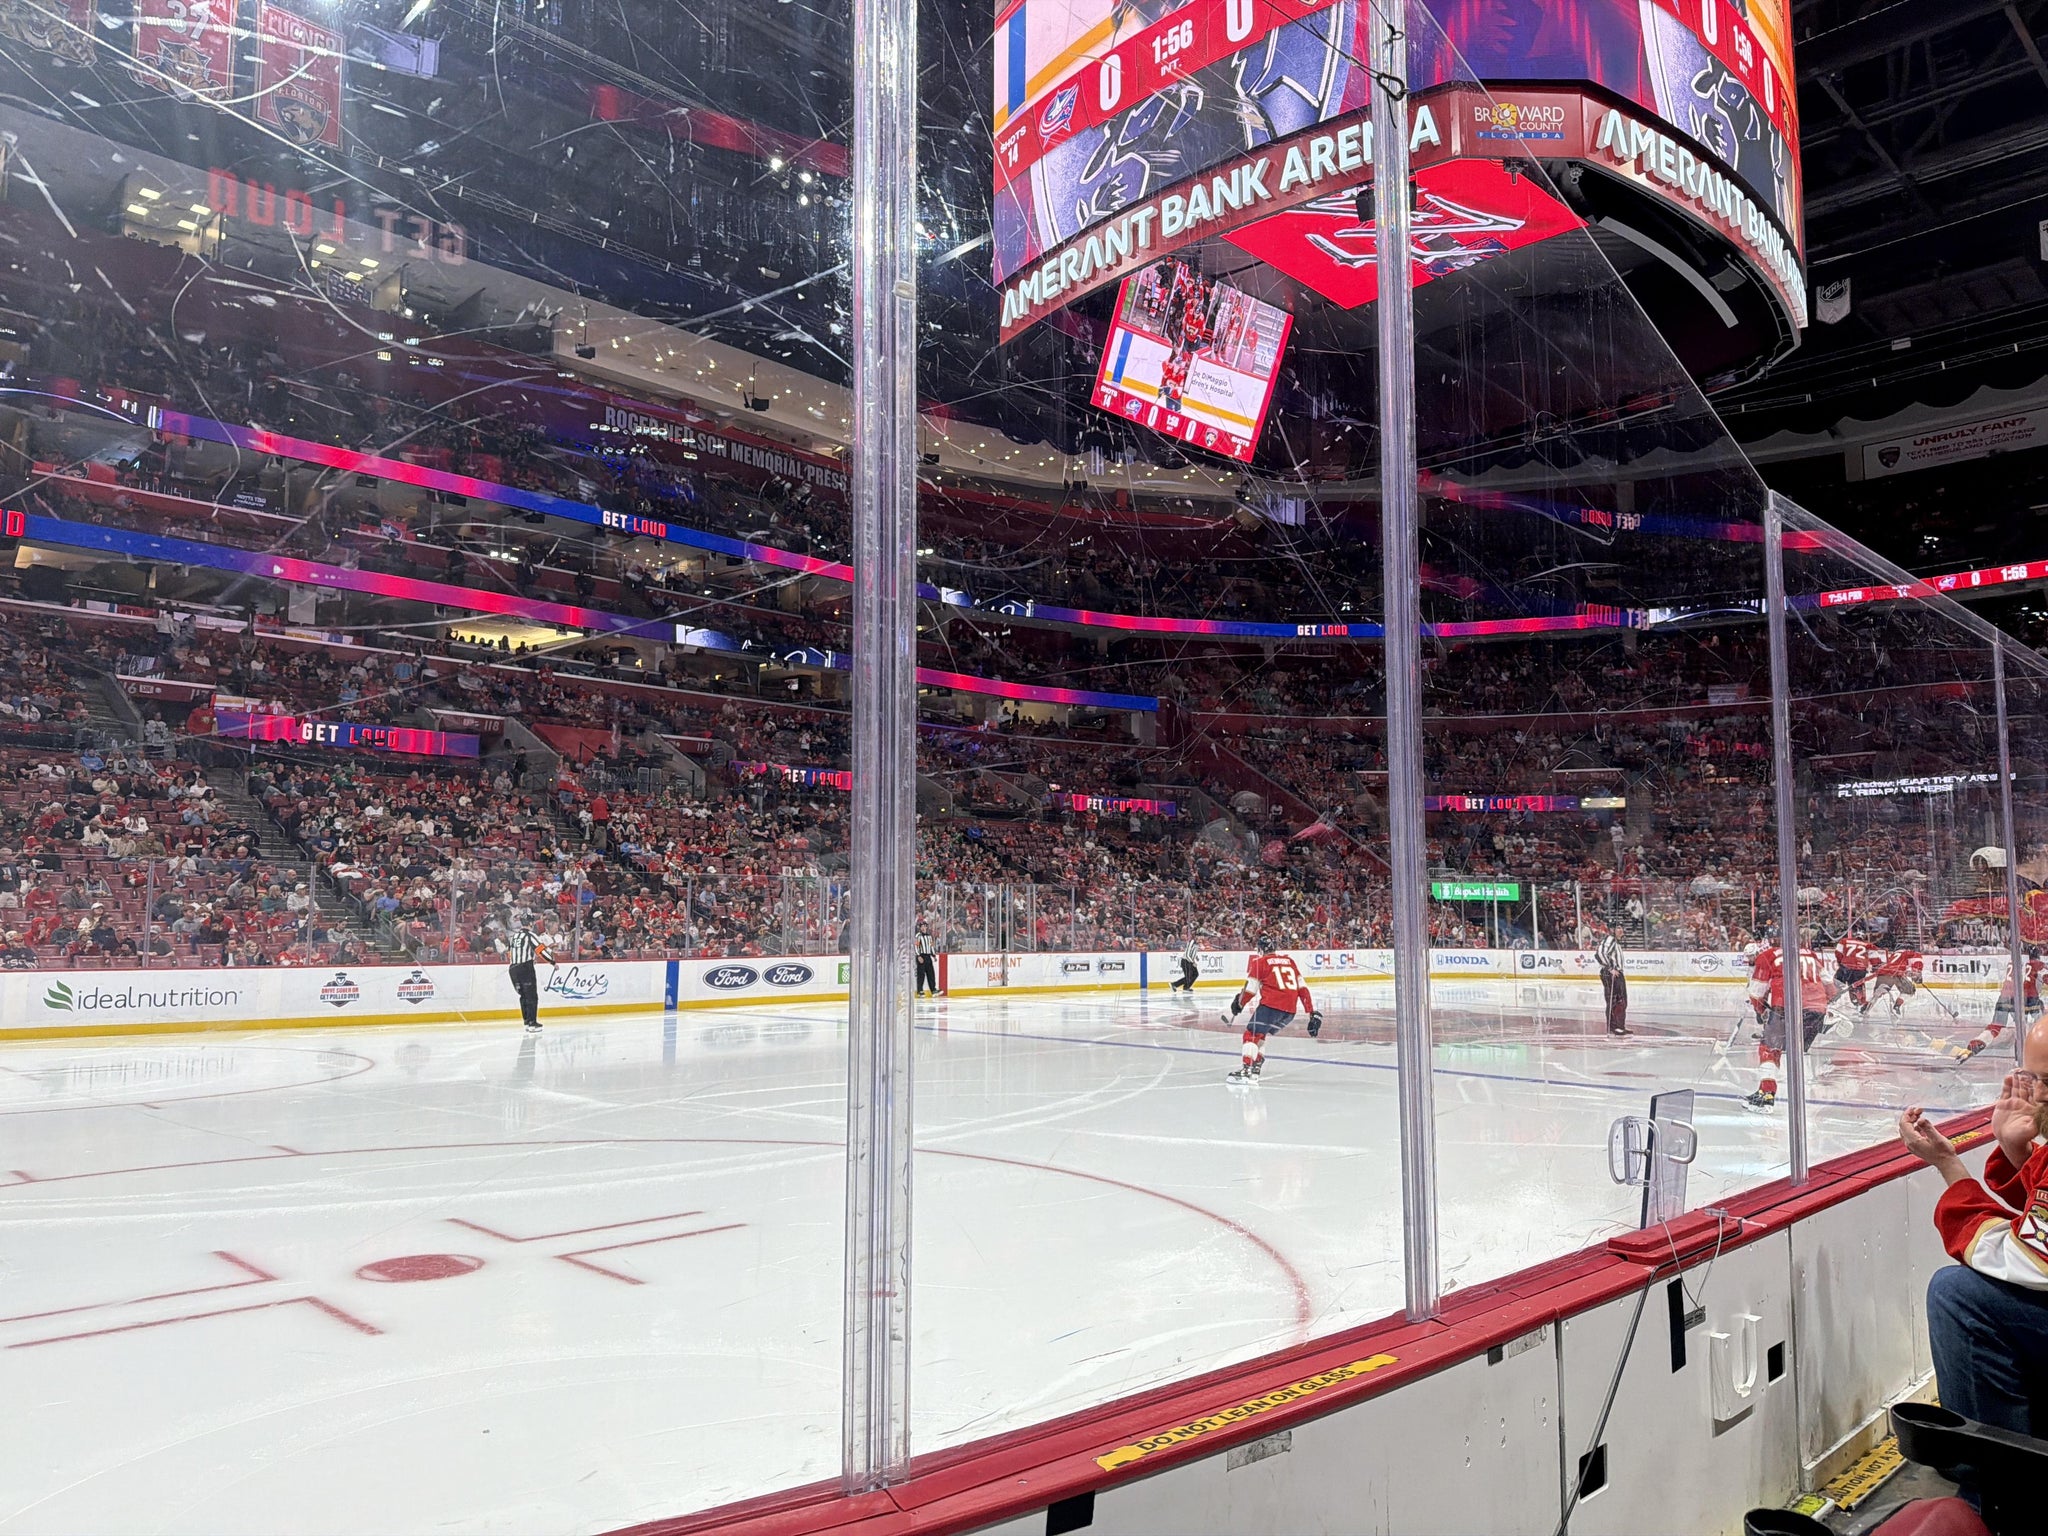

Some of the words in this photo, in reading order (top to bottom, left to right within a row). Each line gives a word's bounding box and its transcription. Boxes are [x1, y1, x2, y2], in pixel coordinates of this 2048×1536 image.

[1226, 0, 1253, 42] 0
[266, 12, 339, 52] LUONGO
[1152, 19, 1193, 64] 1:56
[1160, 62, 1182, 77] INT.
[1100, 54, 1121, 111] 0
[1763, 57, 1774, 114] 0
[1520, 121, 1563, 131] COUNTY
[1000, 125, 1026, 153] SHOTS
[1008, 147, 1018, 168] 14
[1599, 108, 1744, 228] AMERANT
[1743, 199, 1787, 281] BANK
[1001, 209, 1158, 328] AMERANT
[1161, 158, 1275, 239] BANK
[1200, 372, 1229, 388] DiMaggio
[1208, 382, 1234, 399] Hospital
[1148, 405, 1158, 427] 0
[1185, 420, 1197, 441] 0
[1913, 426, 1979, 446] UNRULY
[1981, 417, 2027, 433] FAN?
[731, 443, 804, 480] MEMORIAL
[807, 469, 848, 492] PRESS
[603, 510, 627, 529] GET
[633, 518, 668, 538] LOUD
[1971, 572, 1981, 585] 0
[1297, 625, 1317, 636] GET
[1321, 625, 1348, 636] LOUD
[302, 722, 339, 743] GET
[484, 719, 500, 731] 118
[697, 742, 710, 752] 119
[1465, 798, 1484, 810] GET
[1454, 885, 1480, 897] Baptist
[1315, 953, 1331, 965] CH
[1340, 953, 1355, 964] CH
[1845, 944, 1867, 959] 72
[1445, 956, 1489, 965] HONDA
[1932, 959, 1991, 976] finally
[714, 968, 749, 985] Ford
[772, 966, 804, 983] Ford
[1272, 966, 1298, 990] 13
[1136, 1436, 1174, 1452] DO
[1176, 1418, 1220, 1438] NOT
[1221, 1400, 1272, 1421] LEAN
[1270, 1385, 1301, 1403] ON
[1300, 1368, 1356, 1392] GLASS
[1863, 1460, 1885, 1474] NOT
